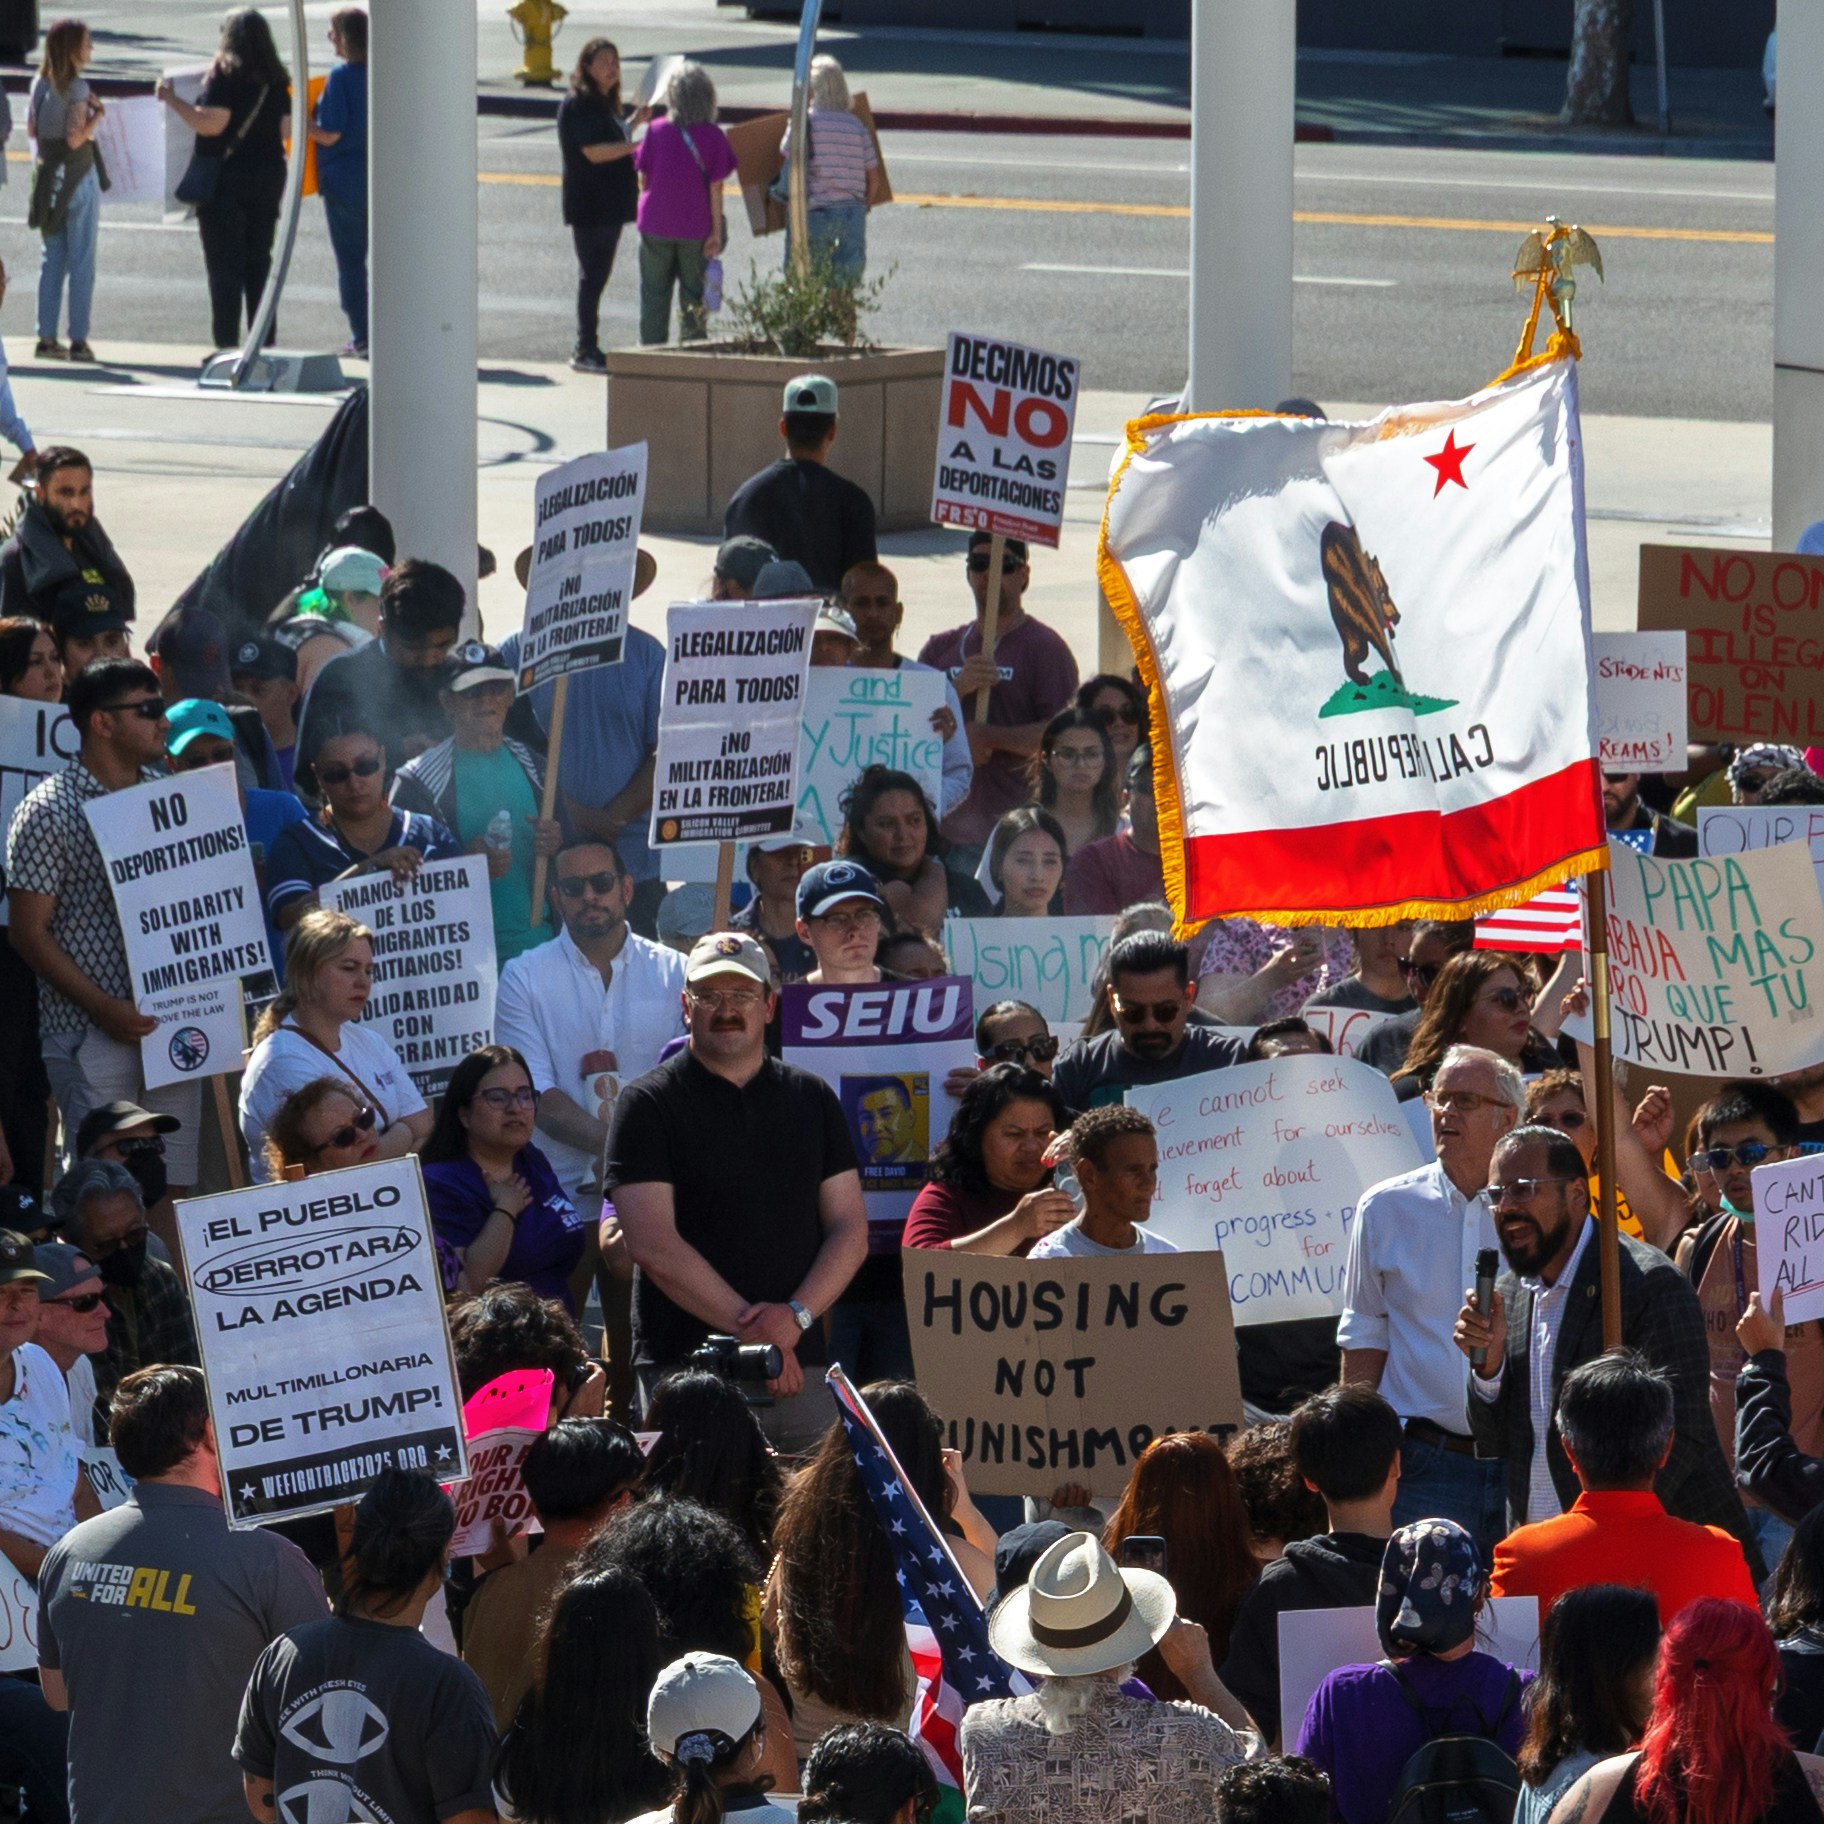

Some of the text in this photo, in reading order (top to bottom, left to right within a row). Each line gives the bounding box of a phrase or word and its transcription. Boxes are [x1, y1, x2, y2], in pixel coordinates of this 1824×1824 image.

[951, 335, 1074, 401] DECIMOS
[948, 379, 1069, 449] NO
[949, 440, 1057, 481] A LAS
[538, 471, 638, 526] ¡LEGALIZACIÓN
[939, 465, 1061, 515] DEPORTACIONES
[537, 516, 631, 565] PARA TODOS!
[559, 573, 581, 601] ¡NO
[1680, 554, 1755, 602] NO
[530, 590, 622, 633] MILITARIZACIÓN
[1742, 603, 1776, 637] IS
[523, 614, 619, 662] EN FRONTERA!
[674, 623, 805, 663] ¡LEGALIZACIÓN
[676, 674, 799, 705] PARA TODOS!
[849, 672, 902, 698] and
[1599, 658, 1684, 682] STUDENTS
[1739, 665, 1786, 691] ON
[721, 731, 751, 757] ¡NO
[829, 712, 942, 770] Justice
[669, 750, 792, 784] MILITARIZACIÓN
[148, 792, 188, 833] NO
[659, 779, 790, 811] EN LA FRONTERA!
[111, 824, 247, 884] DEPORTATIONS!
[140, 886, 244, 935] SOLIDARITY
[336, 868, 469, 912] ¡MANOS FUERA
[1636, 855, 1761, 931] PAPA
[375, 899, 436, 930] DE LOS
[170, 922, 222, 955] WITH
[1707, 917, 1814, 979] MAS
[142, 940, 267, 995] IMMIGRANTS!
[152, 990, 219, 1012] TRUMP NOT
[182, 1003, 225, 1020] THE LAW
[801, 985, 960, 1039] SEIU
[1666, 970, 1807, 1024] QUE TU
[393, 1015, 433, 1039] CON
[1615, 1005, 1762, 1075] TRUMP!
[1199, 1069, 1349, 1116] cannot seek
[1272, 1115, 1401, 1143] for ourselves
[864, 1165, 883, 1177] FREE
[1185, 1159, 1321, 1202] forget about
[202, 1186, 401, 1248] ¡EL PUEBLO
[1214, 1206, 1317, 1249] progress
[209, 1225, 416, 1289] DERROTARÁ
[1303, 1235, 1334, 1258] for
[1775, 1256, 1814, 1292] ALL
[216, 1274, 423, 1331] LA AGENDA
[923, 1271, 1189, 1334] HOUSING
[226, 1353, 433, 1405] MULTIMILLONARIA
[994, 1356, 1096, 1399] NOT
[230, 1386, 443, 1448] DE TRUMP!
[71, 1562, 196, 1615] UNITED FOR ALL
[290, 1679, 367, 1708] WITH FRESH EYES
[310, 1769, 338, 1778] THINK
